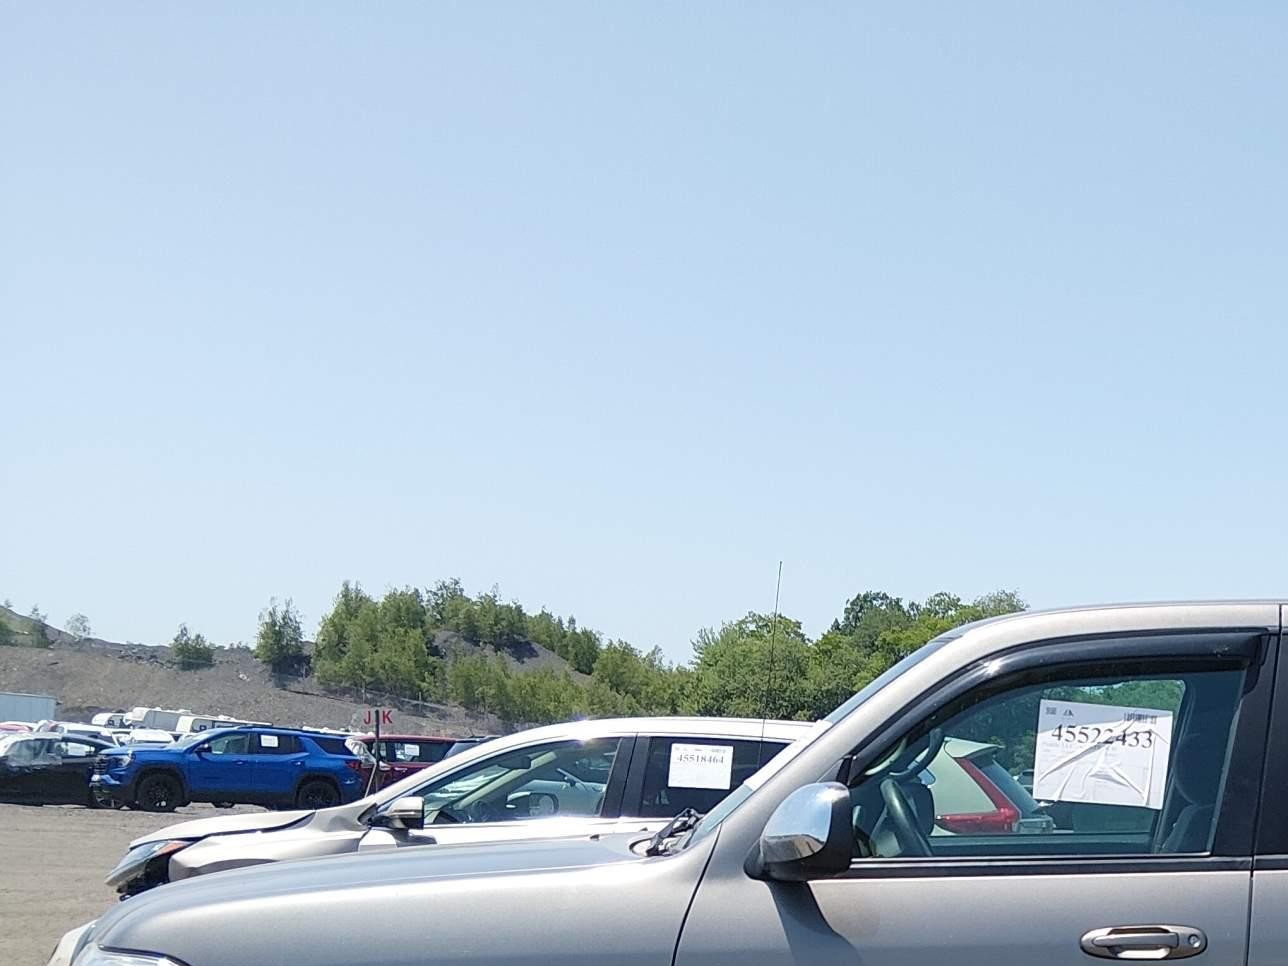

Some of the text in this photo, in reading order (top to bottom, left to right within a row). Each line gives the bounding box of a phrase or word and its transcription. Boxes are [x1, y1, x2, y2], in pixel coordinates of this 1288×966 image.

[363, 709, 393, 725] J K
[1051, 723, 1153, 749] 45522433
[677, 754, 724, 764] 45518464
